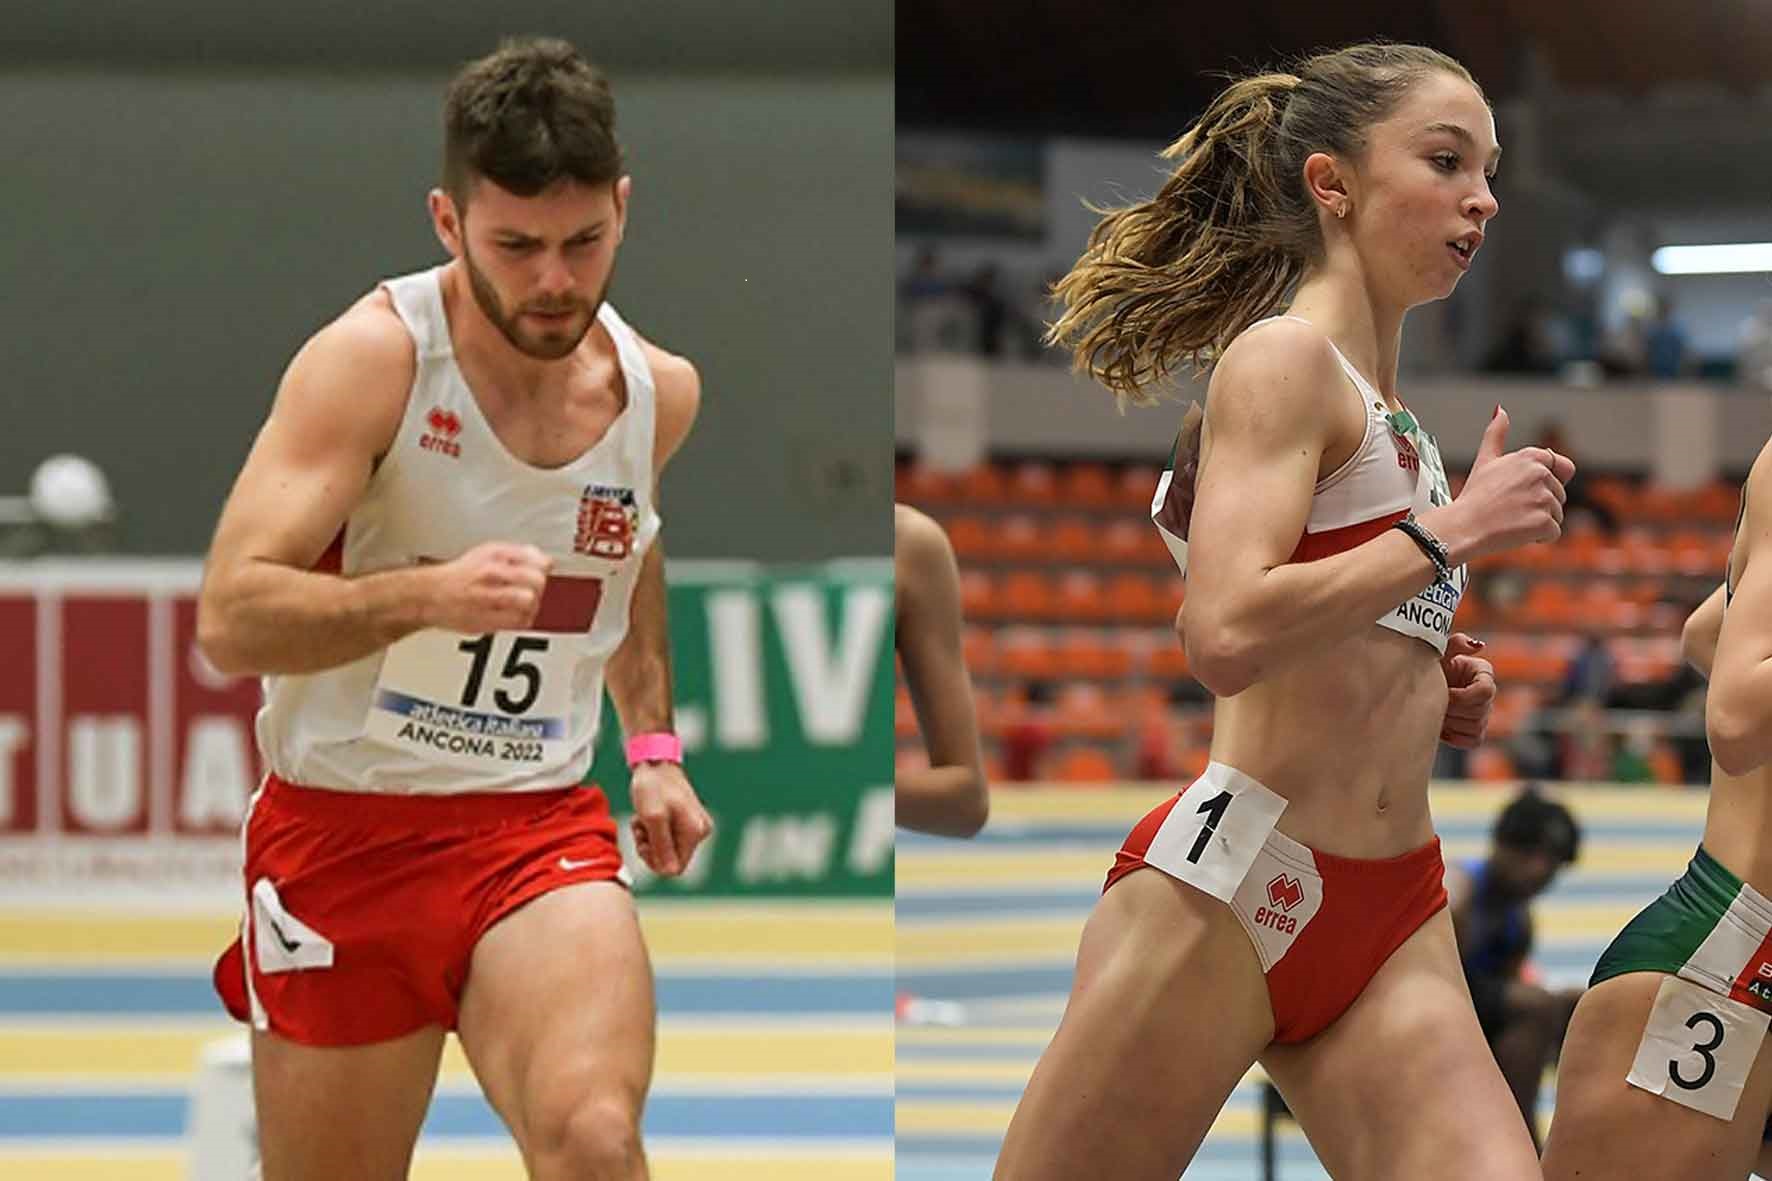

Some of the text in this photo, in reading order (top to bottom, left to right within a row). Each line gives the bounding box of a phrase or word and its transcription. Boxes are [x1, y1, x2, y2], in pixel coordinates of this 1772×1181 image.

[1397, 451, 1419, 472] err
[458, 633, 549, 715] 15
[397, 722, 544, 762] ANCONA 2022
[1186, 790, 1234, 865] 1
[1254, 905, 1298, 936] errea
[1667, 1011, 1725, 1091] 3
